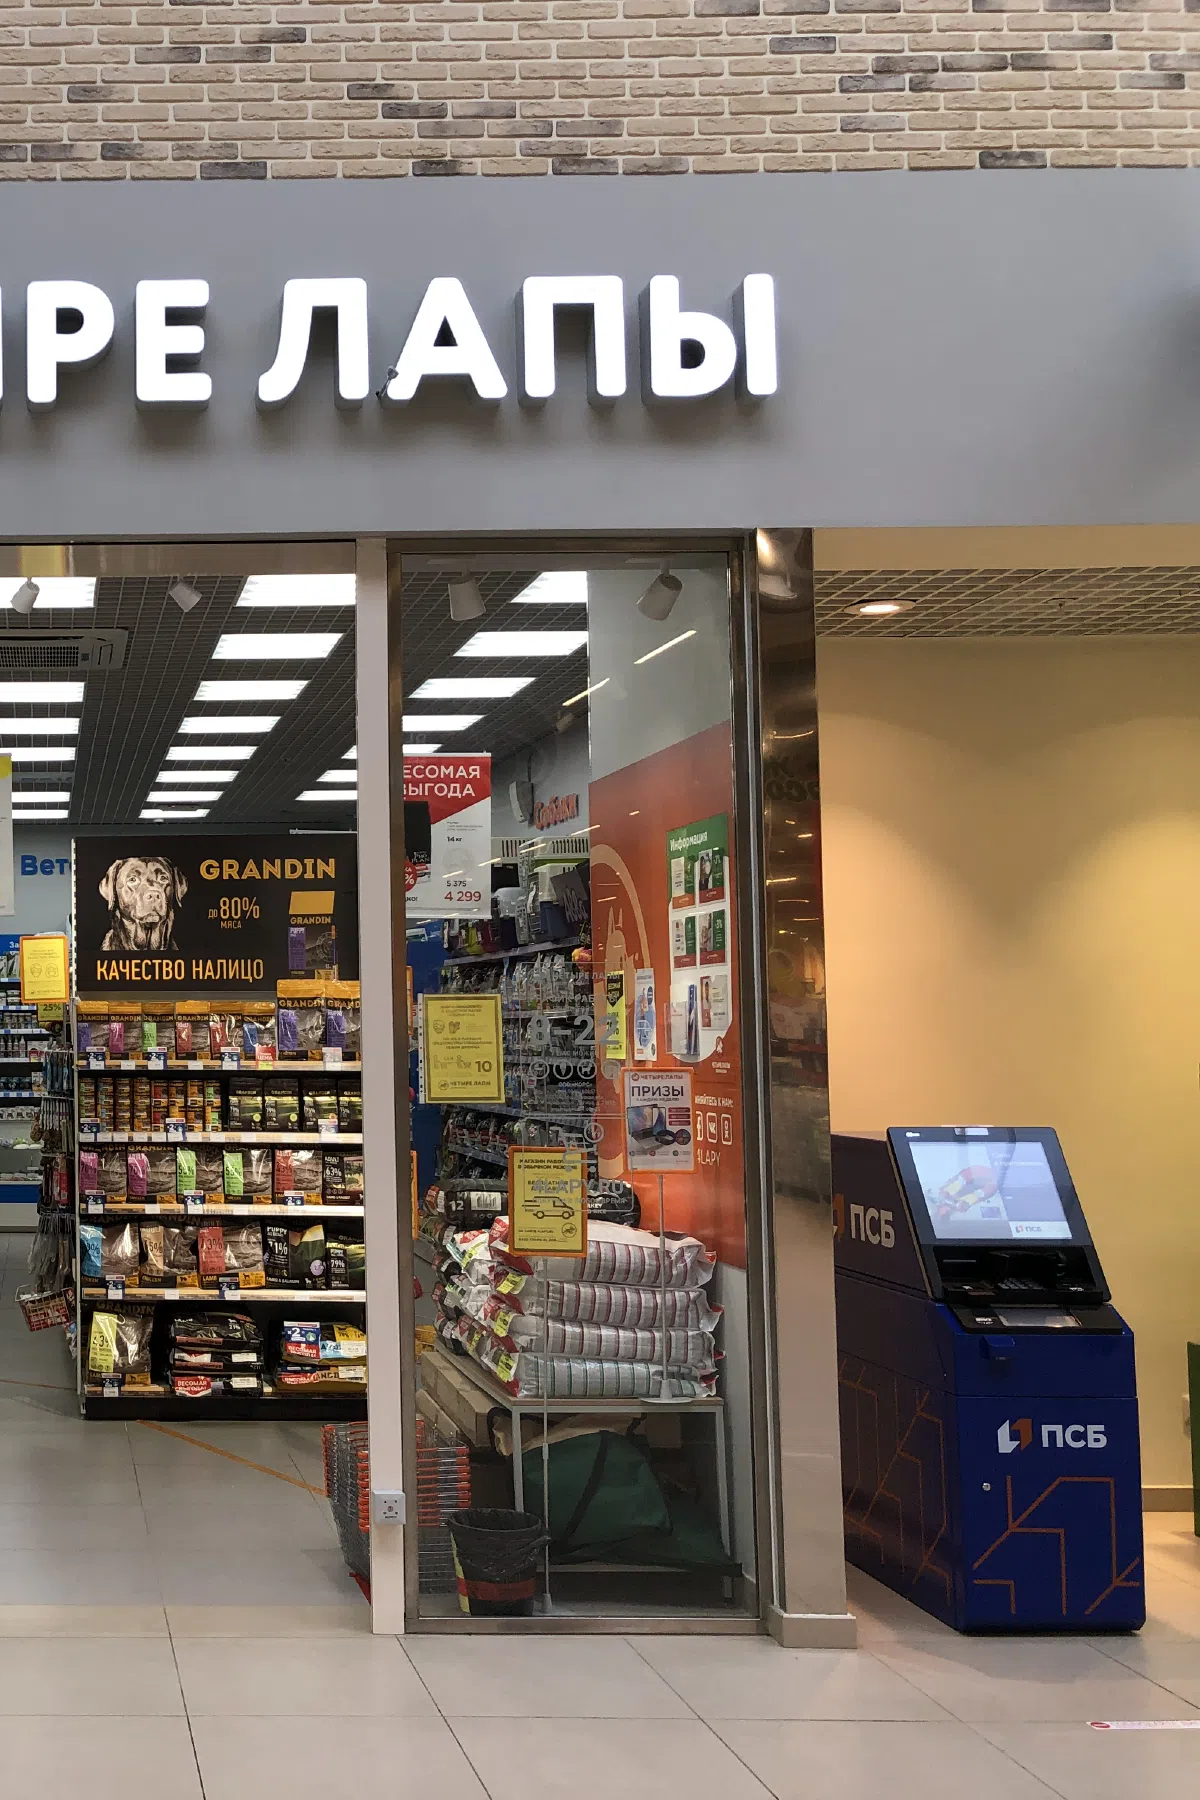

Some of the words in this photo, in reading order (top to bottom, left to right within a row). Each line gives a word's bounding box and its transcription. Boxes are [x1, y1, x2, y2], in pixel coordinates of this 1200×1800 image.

[258, 273, 778, 402] ЛАПЫ
[403, 764, 480, 779] ЕСОМАЯ
[670, 831, 708, 852] Информация
[21, 854, 71, 876] Вет
[200, 858, 336, 880] GRANDIN
[444, 891, 453, 901] 4
[456, 891, 482, 902] 299
[220, 896, 260, 919] 80%
[221, 920, 242, 929] МЯСА
[290, 916, 332, 924] GRANDIN
[9, 941, 19, 949] За
[96, 959, 186, 981] КАЧЕСТВО
[192, 958, 264, 983] НАЛИЦО
[43, 1003, 62, 1011] 25%
[279, 999, 324, 1008] GRANDIN
[327, 1000, 360, 1008] GRAND
[475, 1060, 492, 1073] 10
[631, 1085, 684, 1097] ПРИЗЫ
[449, 1200, 464, 1211] 12
[850, 1203, 895, 1249] ПСБ
[1041, 1424, 1108, 1449] ПСБ
